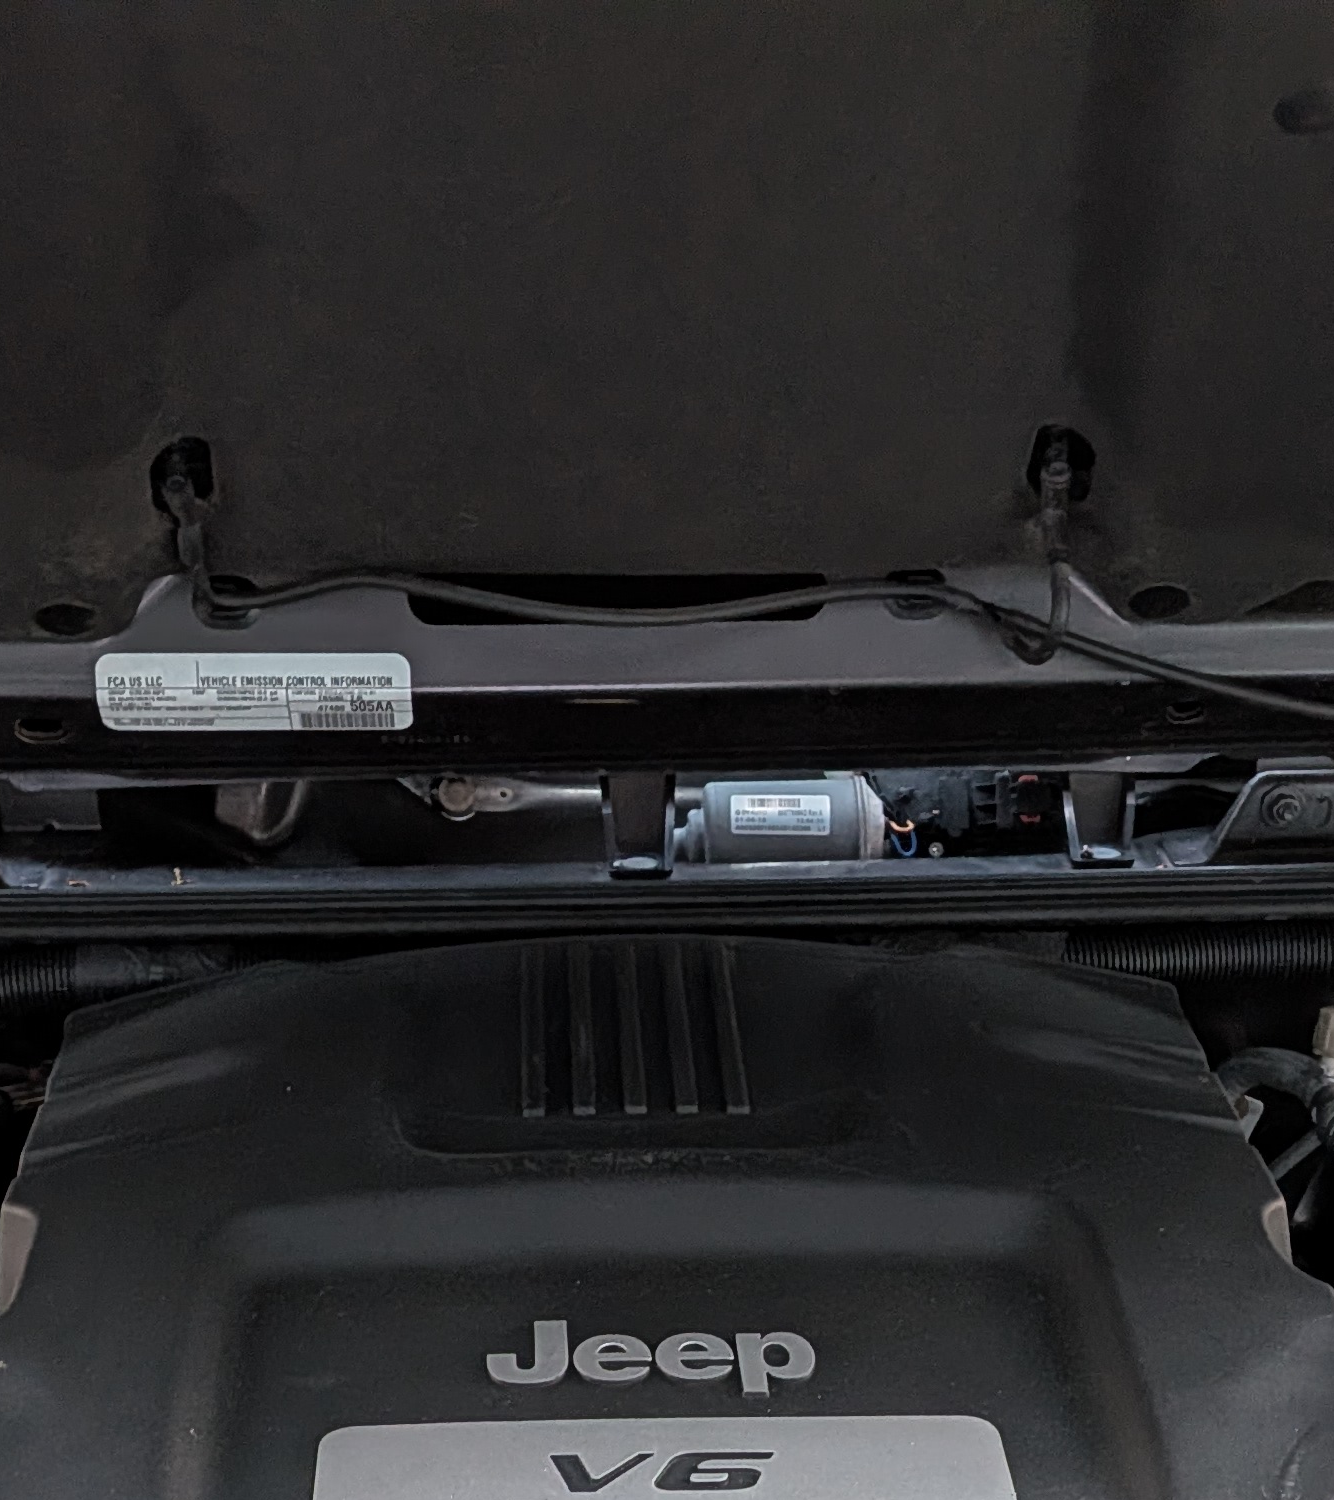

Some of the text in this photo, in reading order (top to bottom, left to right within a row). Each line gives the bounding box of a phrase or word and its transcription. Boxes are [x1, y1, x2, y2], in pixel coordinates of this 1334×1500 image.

[108, 676, 163, 686] FCA US LLC
[200, 676, 393, 687] VEHICLE EMISSION CONTROL INFORMATION
[350, 701, 394, 712] 505AA
[486, 1320, 816, 1397] Jeep
[550, 1452, 774, 1493] V6
